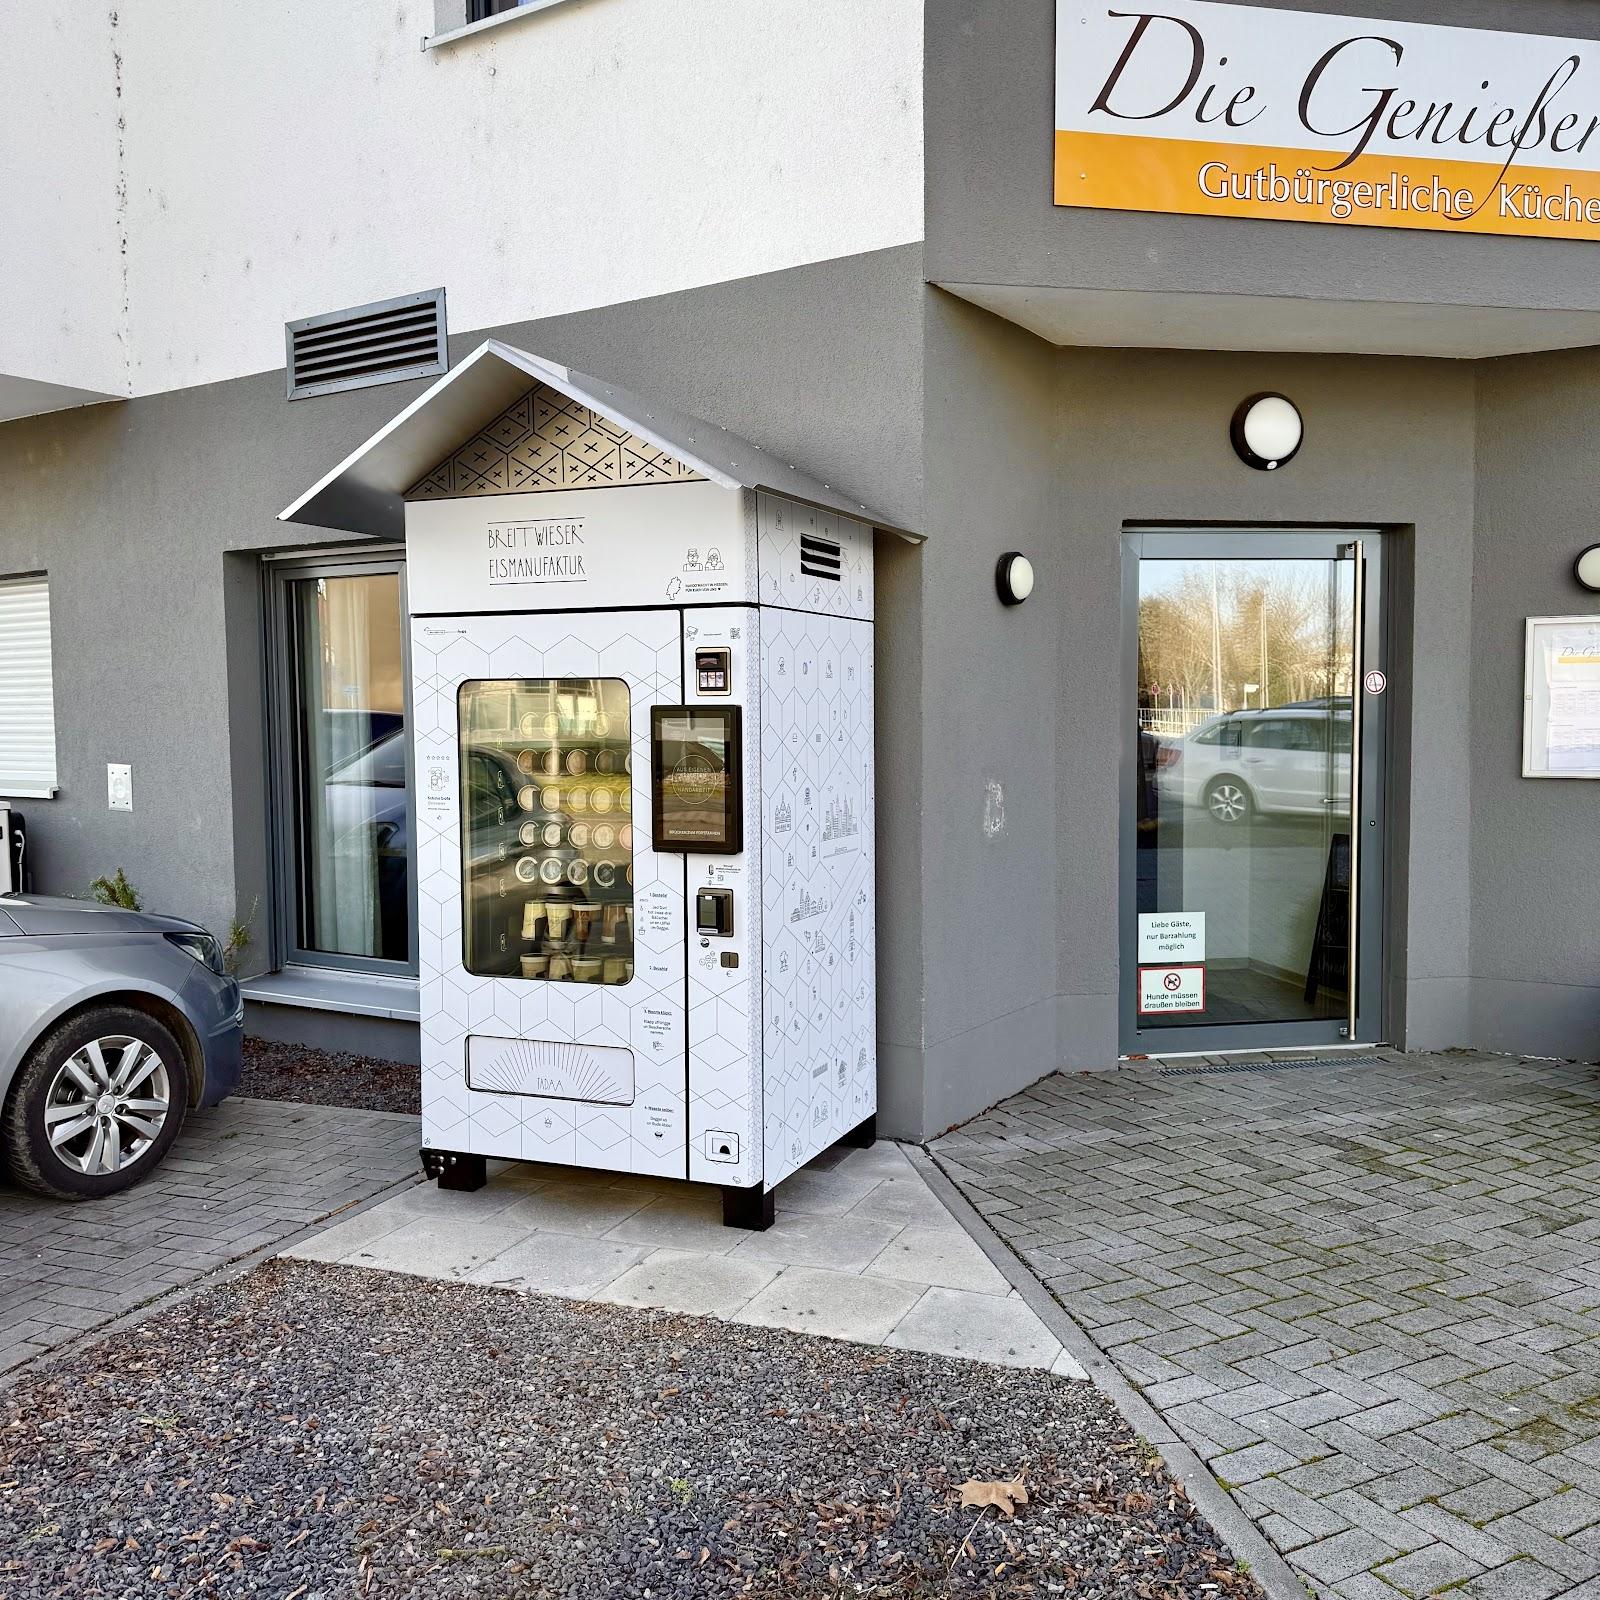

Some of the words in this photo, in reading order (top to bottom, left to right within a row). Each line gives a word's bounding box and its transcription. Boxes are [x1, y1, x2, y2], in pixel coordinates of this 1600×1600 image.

[1087, 9, 1267, 127] Die
[1197, 161, 1475, 218] Gutbürgerliche
[1498, 182, 1600, 225] Küche
[489, 555, 586, 579] EISMANUFAKTUR
[1170, 920, 1192, 928] Gäste,
[1159, 932, 1197, 940] Barzahlung
[1158, 943, 1185, 951] möglich
